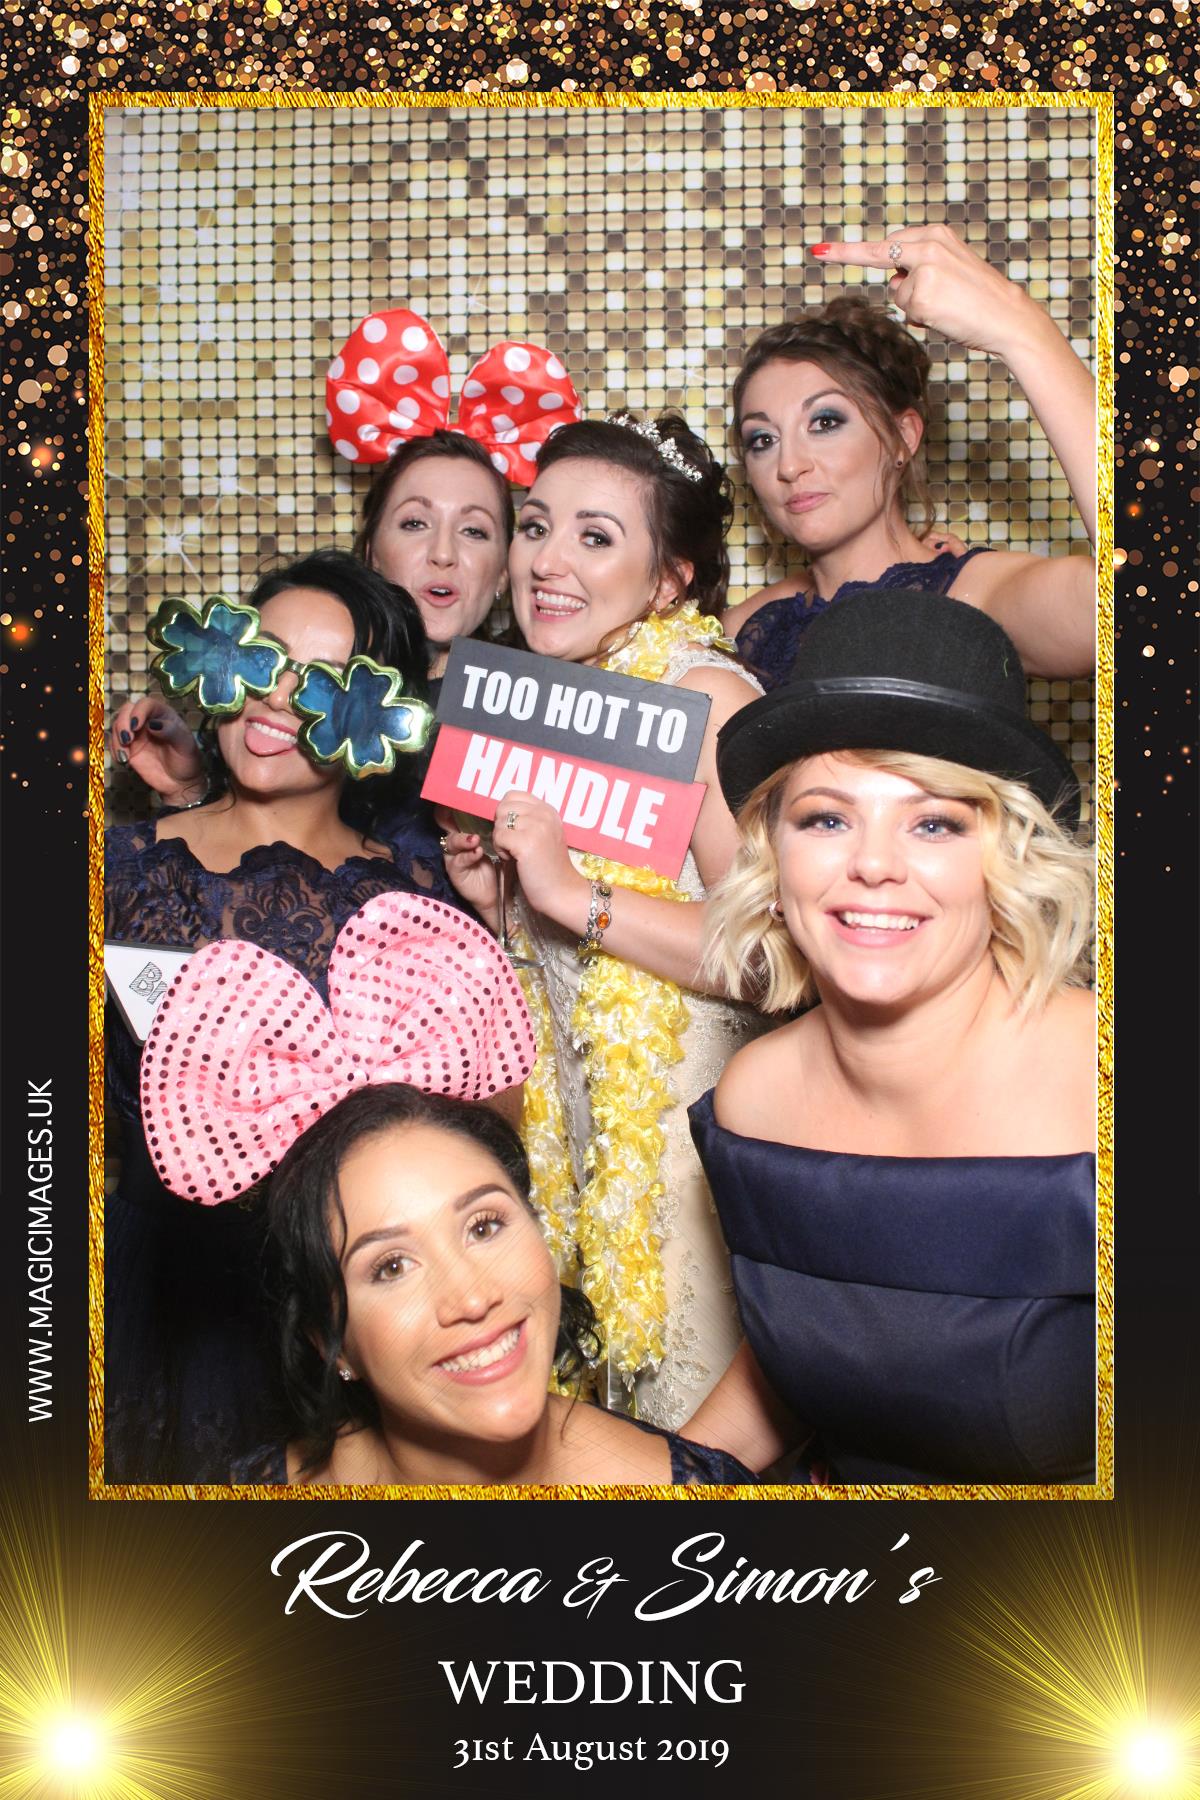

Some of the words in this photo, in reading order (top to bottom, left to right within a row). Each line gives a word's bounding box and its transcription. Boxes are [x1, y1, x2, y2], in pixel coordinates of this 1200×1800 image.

[462, 664, 540, 721] TOO
[543, 683, 629, 740] HOT
[636, 702, 688, 754] TO
[456, 734, 666, 849] HANDLE
